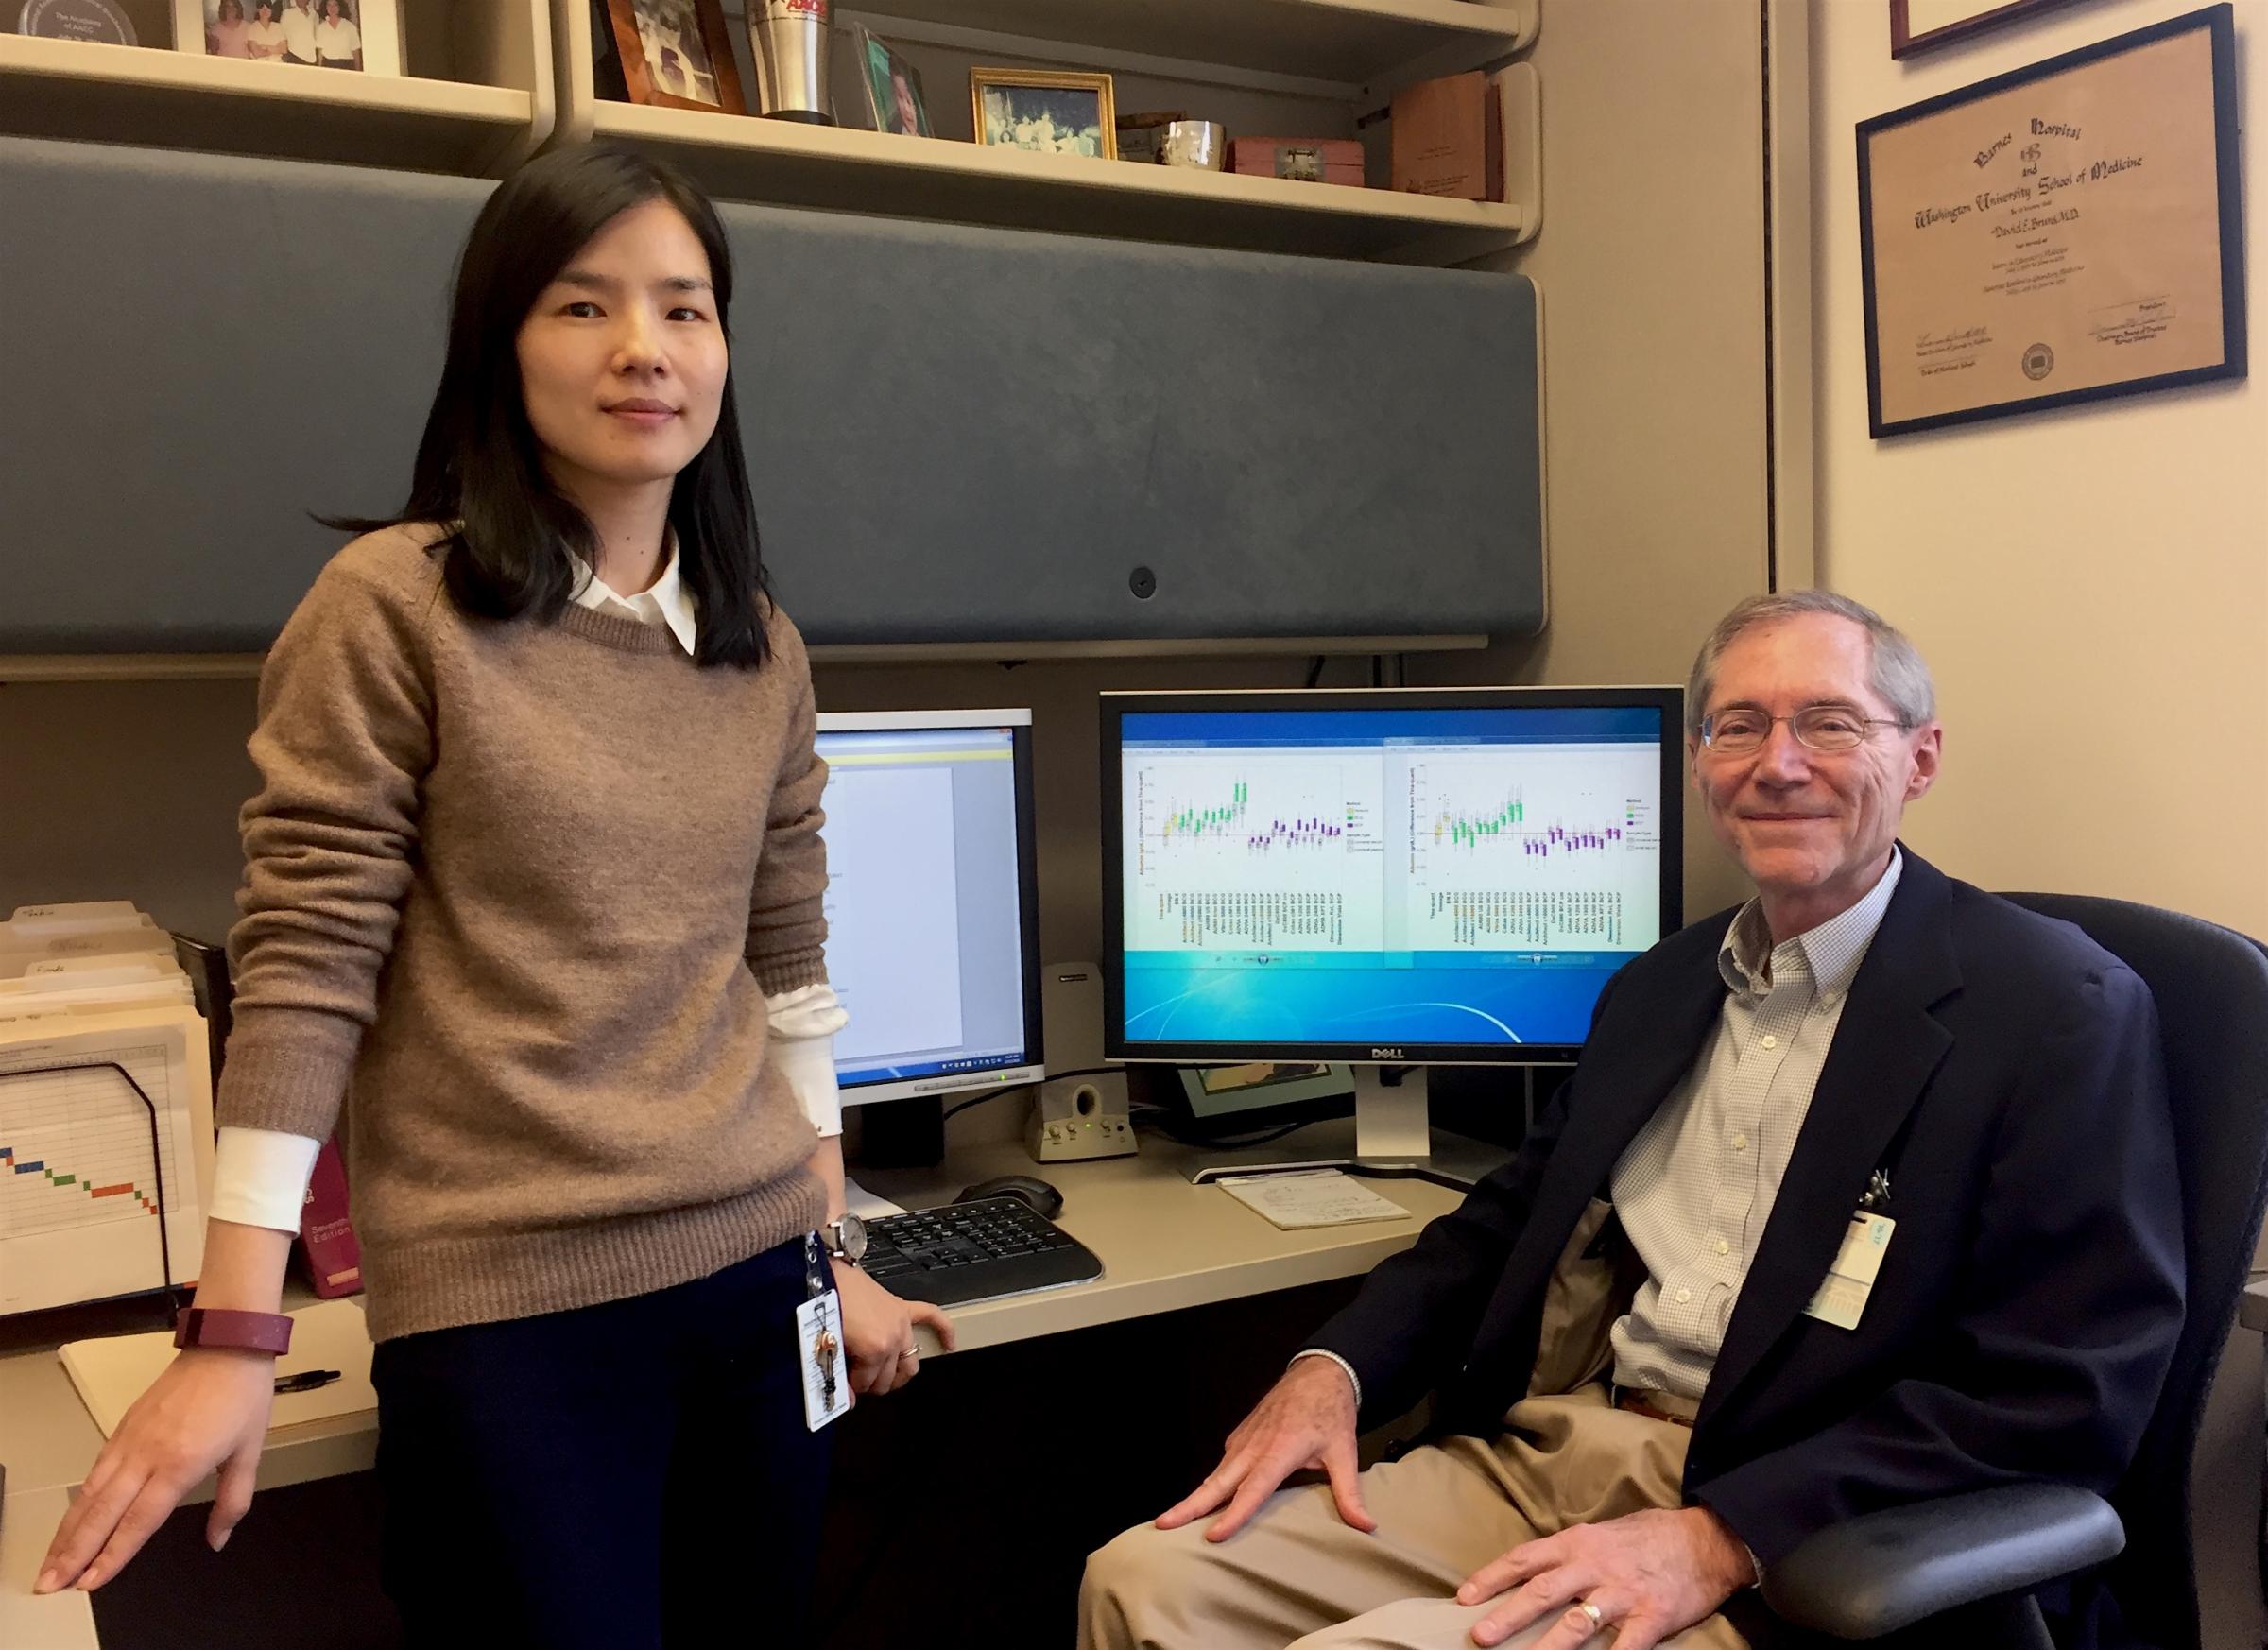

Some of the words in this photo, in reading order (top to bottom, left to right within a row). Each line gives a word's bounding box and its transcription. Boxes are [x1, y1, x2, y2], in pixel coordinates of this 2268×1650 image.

[1973, 132, 2012, 168] Barnes
[2022, 163, 2038, 177] and
[1915, 205, 1971, 229] Washington
[1976, 188, 2031, 212] University
[2038, 173, 2072, 195] School
[2076, 168, 2086, 185] of
[2091, 156, 2142, 181] Medicine
[1371, 1048, 1405, 1059] DELL
[312, 1226, 352, 1244] Edition
